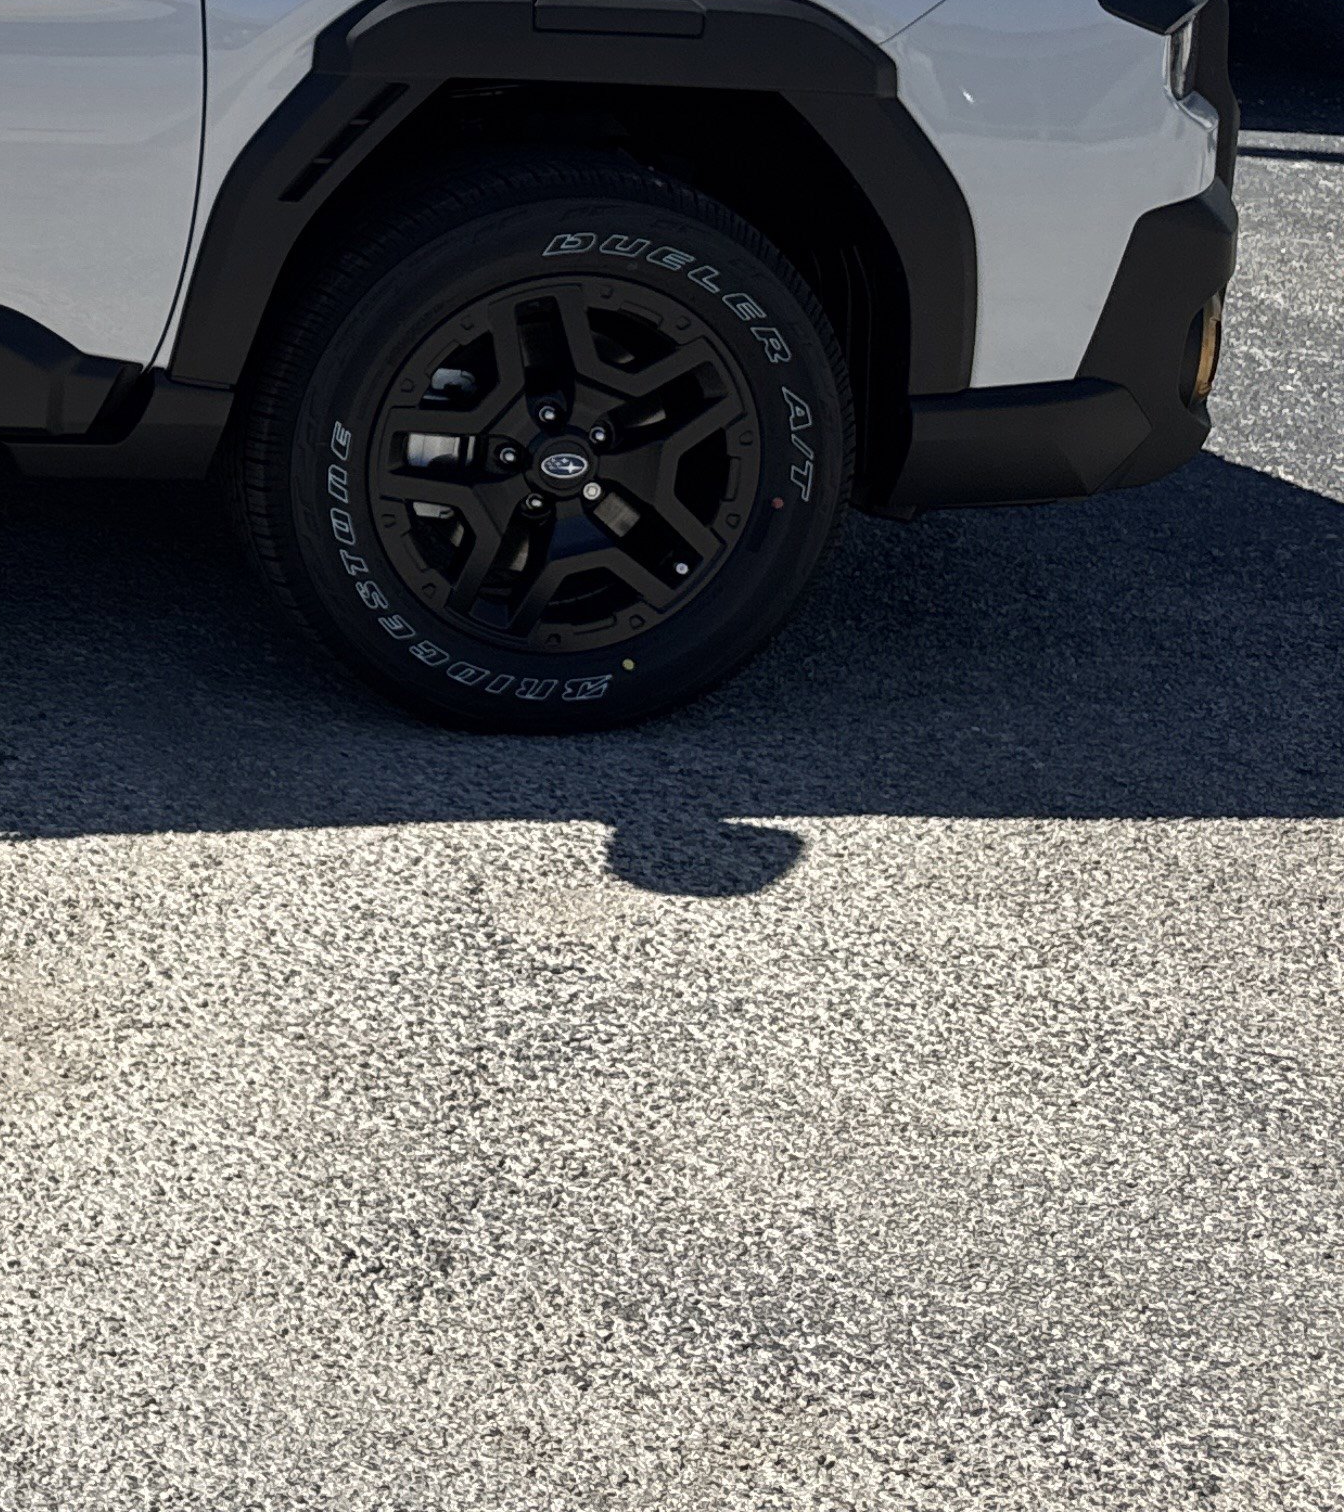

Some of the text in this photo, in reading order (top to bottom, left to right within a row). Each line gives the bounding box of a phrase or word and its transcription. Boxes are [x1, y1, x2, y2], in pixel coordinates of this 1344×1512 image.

[541, 231, 815, 501] DUELER A/T
[325, 419, 615, 702] BRIDGESTONE
